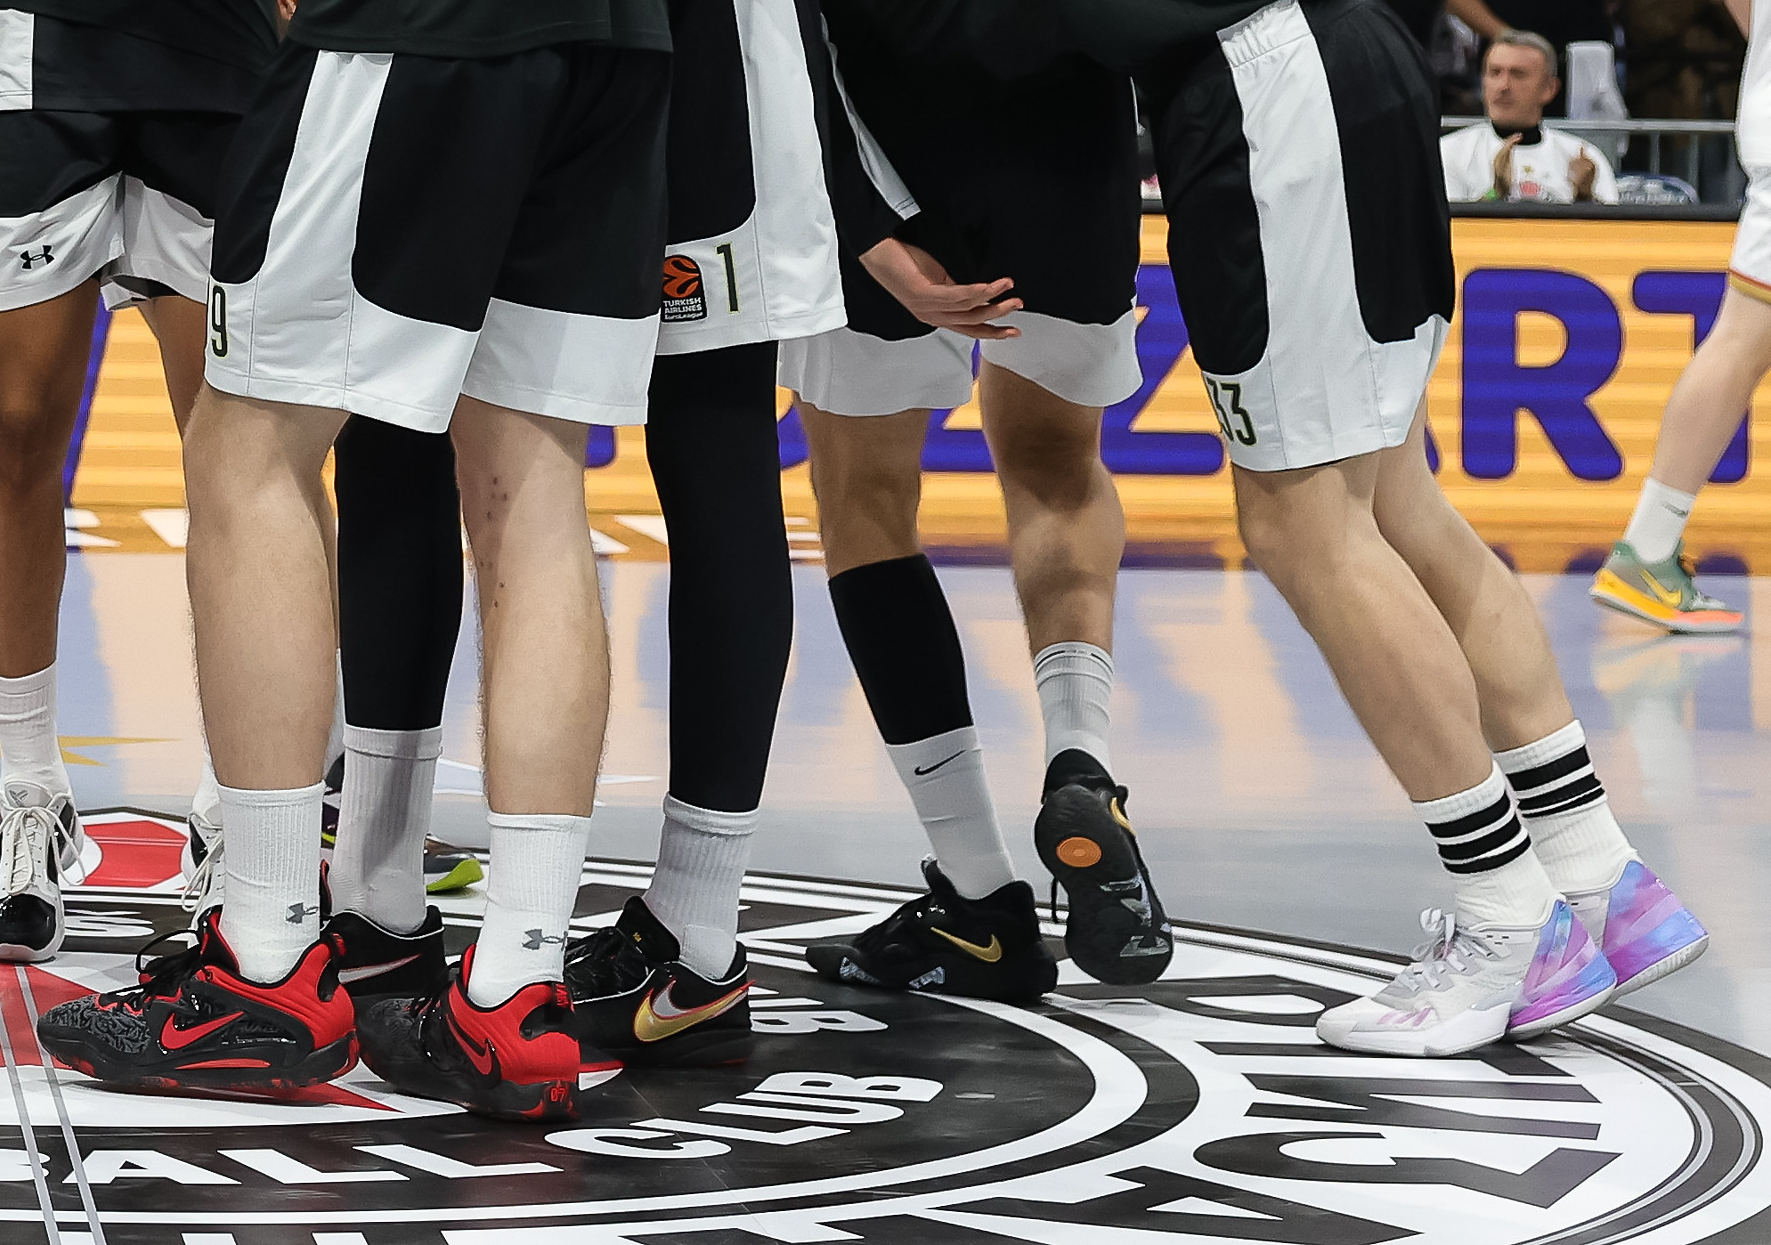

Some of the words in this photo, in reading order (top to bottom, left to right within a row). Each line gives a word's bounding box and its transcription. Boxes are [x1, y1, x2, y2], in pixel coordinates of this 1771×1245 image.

[714, 242, 740, 314] 1
[662, 297, 702, 307] TURKISH
[664, 303, 703, 314] AIRLINES
[544, 1069, 945, 1159] CLUB
